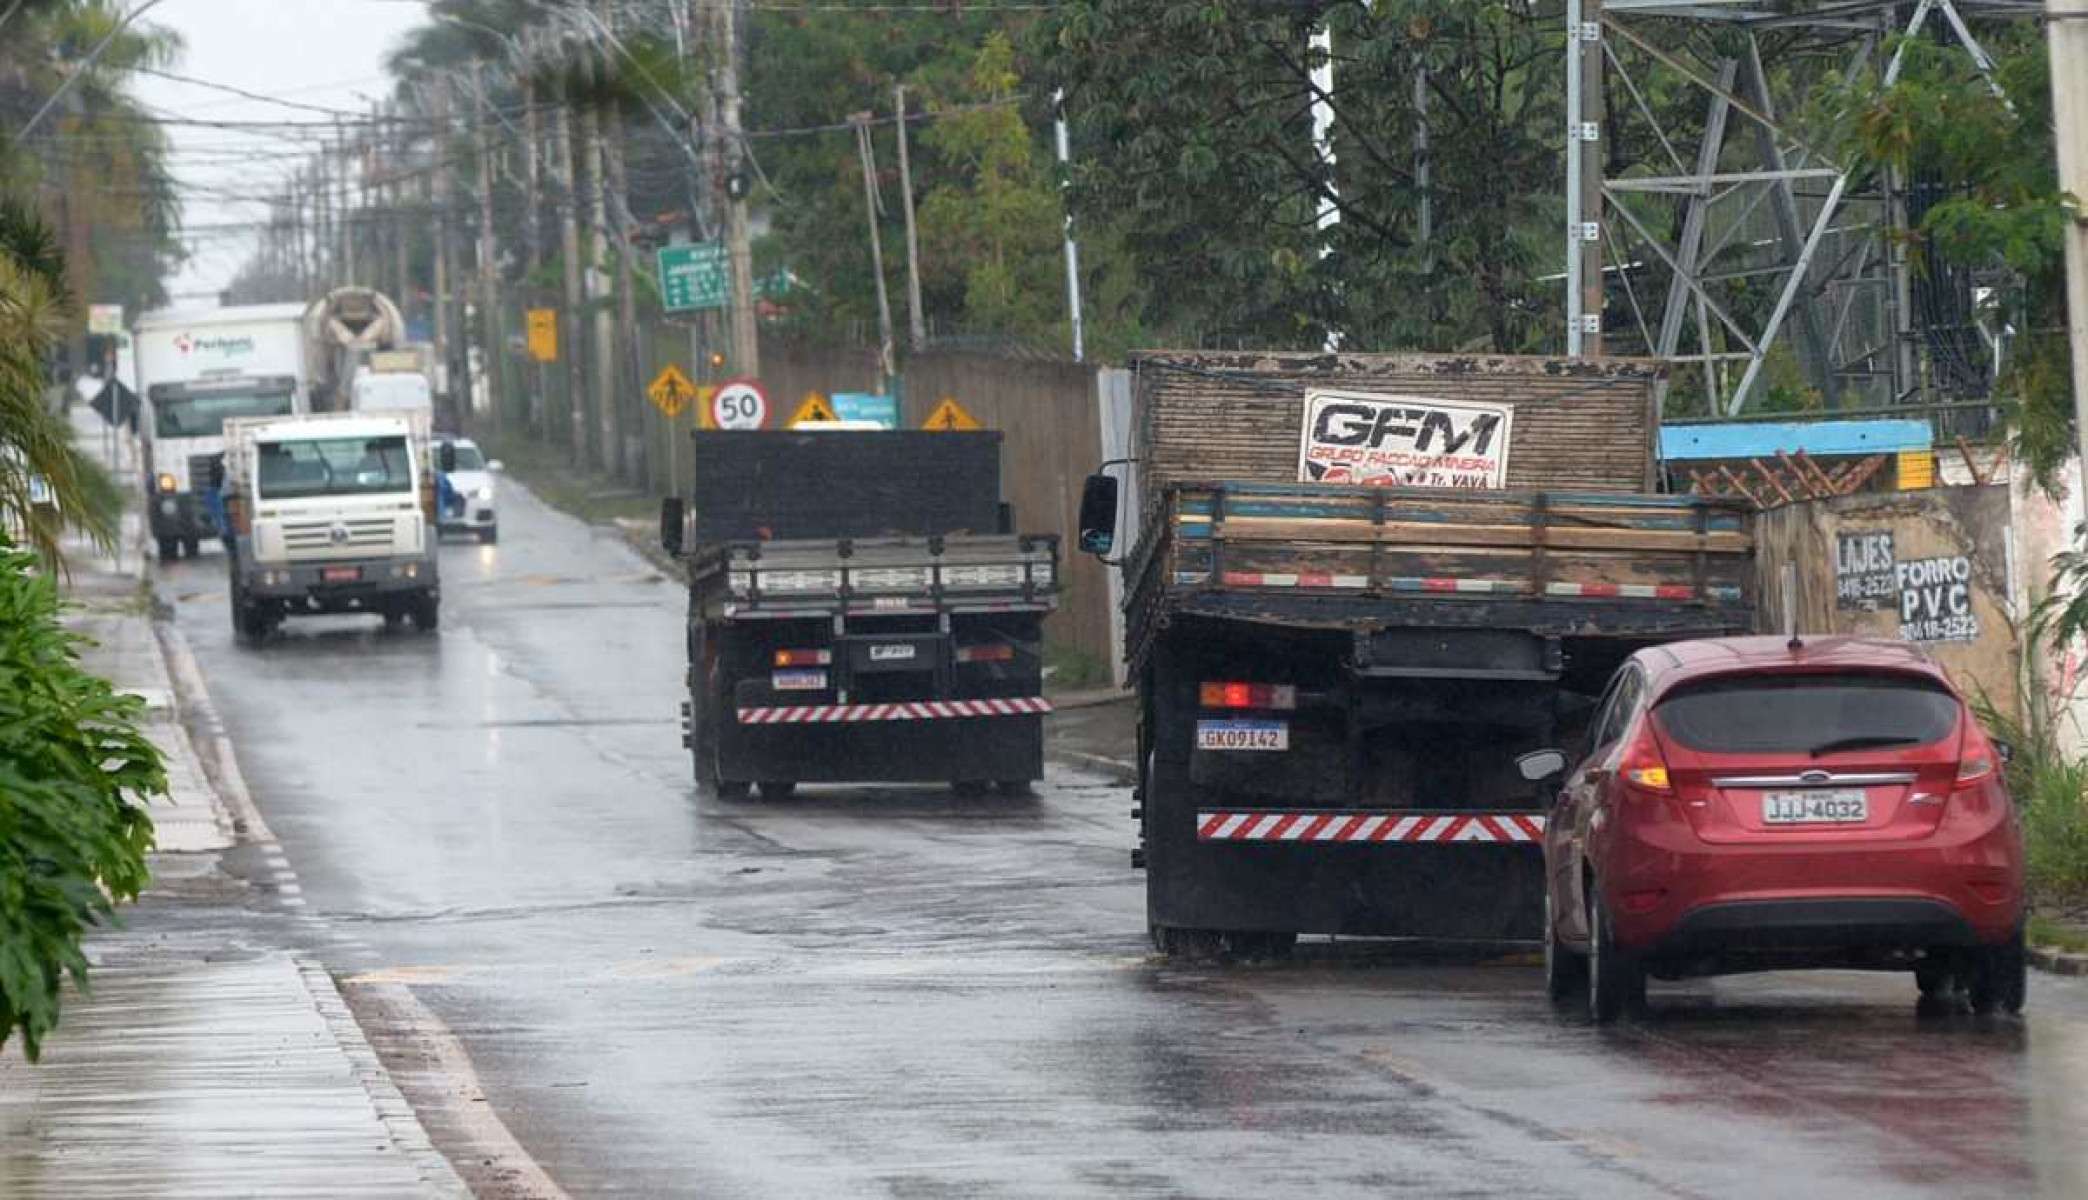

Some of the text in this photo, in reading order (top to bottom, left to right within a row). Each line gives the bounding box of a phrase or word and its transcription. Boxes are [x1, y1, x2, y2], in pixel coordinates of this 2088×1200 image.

[721, 394, 758, 421] 50
[1313, 404, 1500, 455] GFM
[1309, 447, 1364, 464] GRUPO
[1896, 556, 1969, 589] FORRO
[1768, 795, 1863, 819] JJJ-4032
